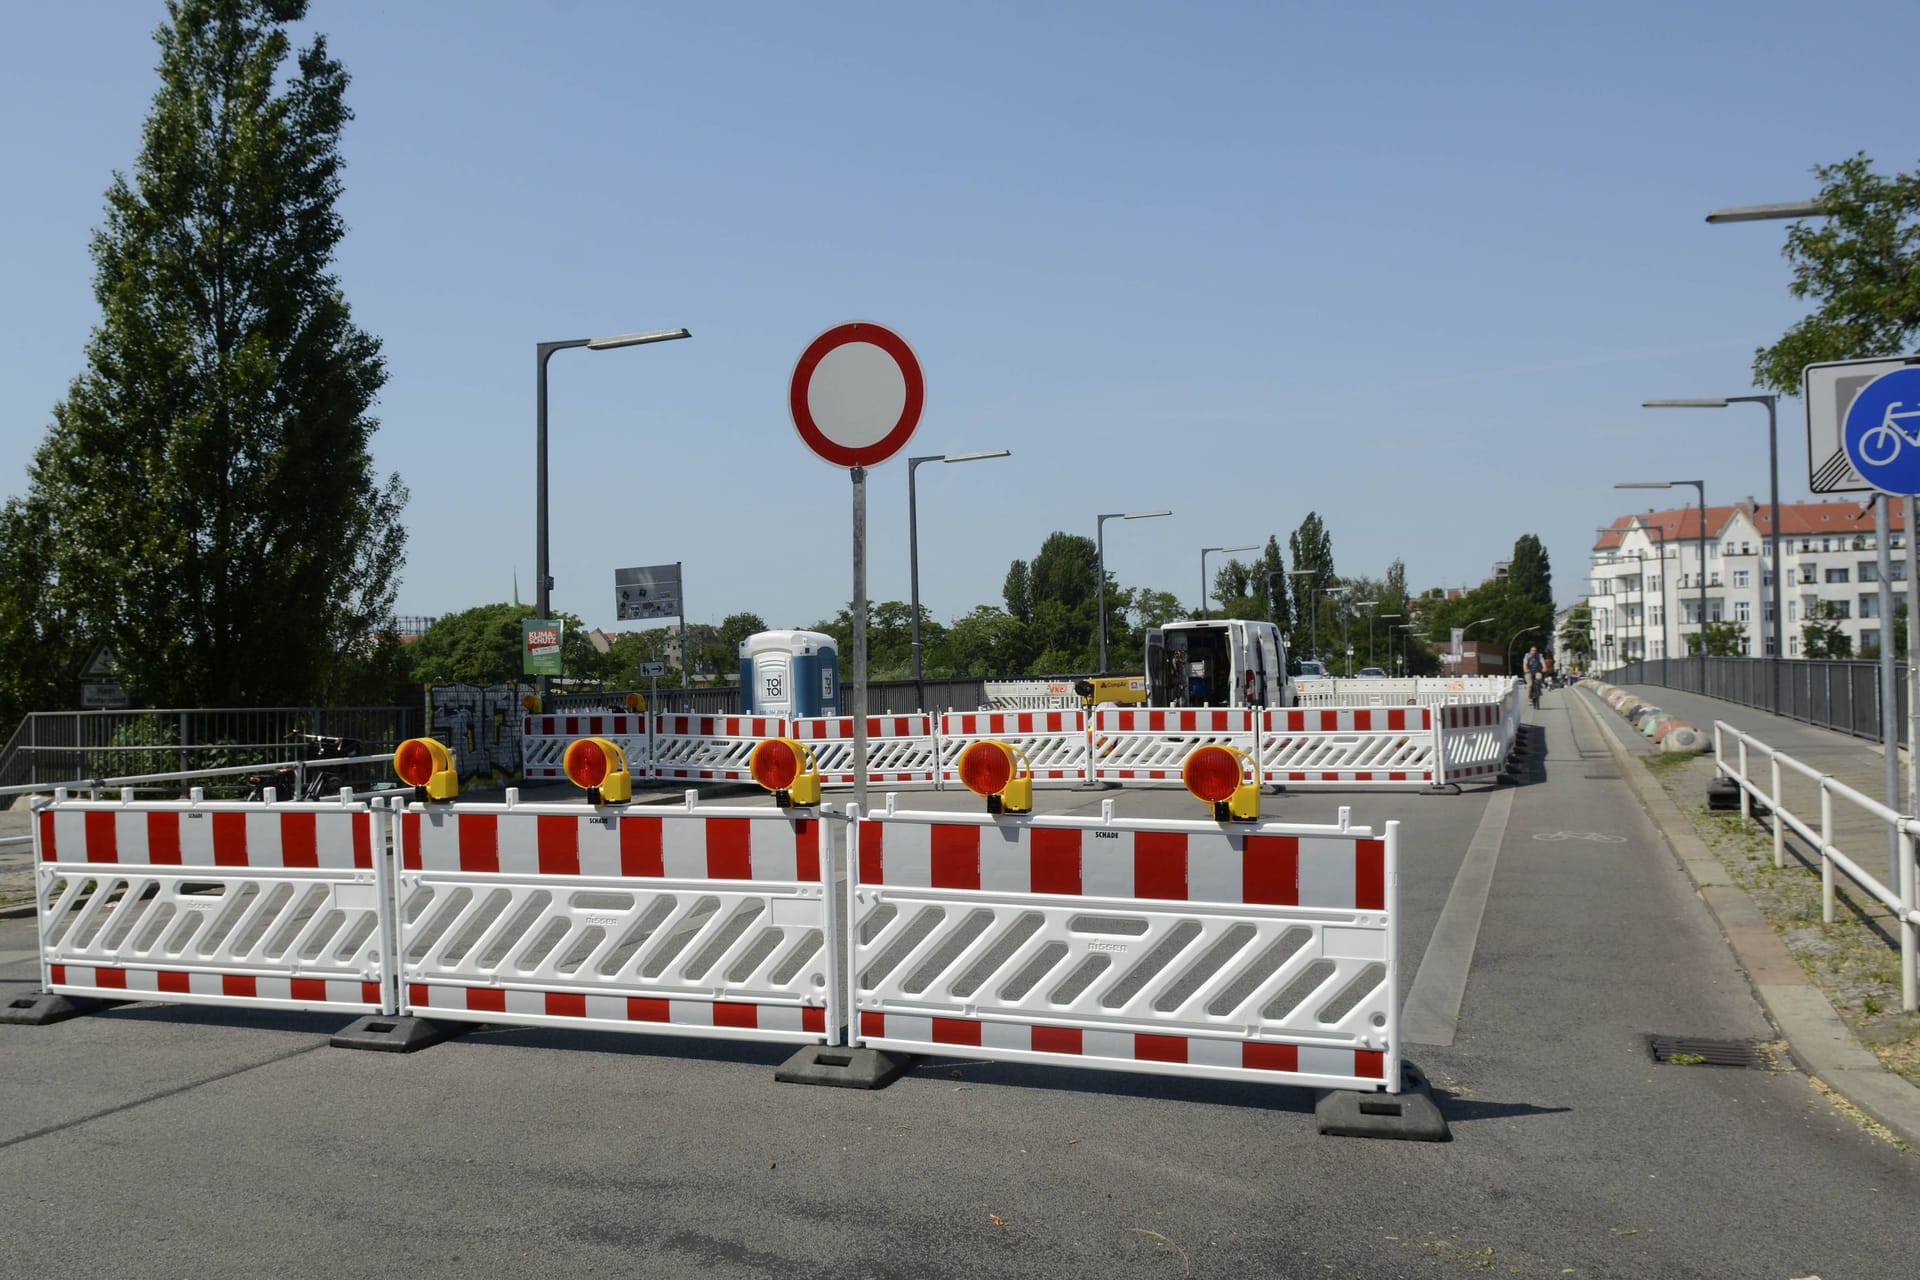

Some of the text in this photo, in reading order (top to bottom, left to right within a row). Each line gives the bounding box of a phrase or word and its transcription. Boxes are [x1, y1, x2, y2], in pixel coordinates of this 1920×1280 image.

[528, 631, 556, 639] KLIMA-
[528, 637, 557, 645] SCHUTZ
[766, 687, 782, 697] TOI
[1095, 831, 1119, 839] SCHADE
[1087, 938, 1128, 953] nissen
